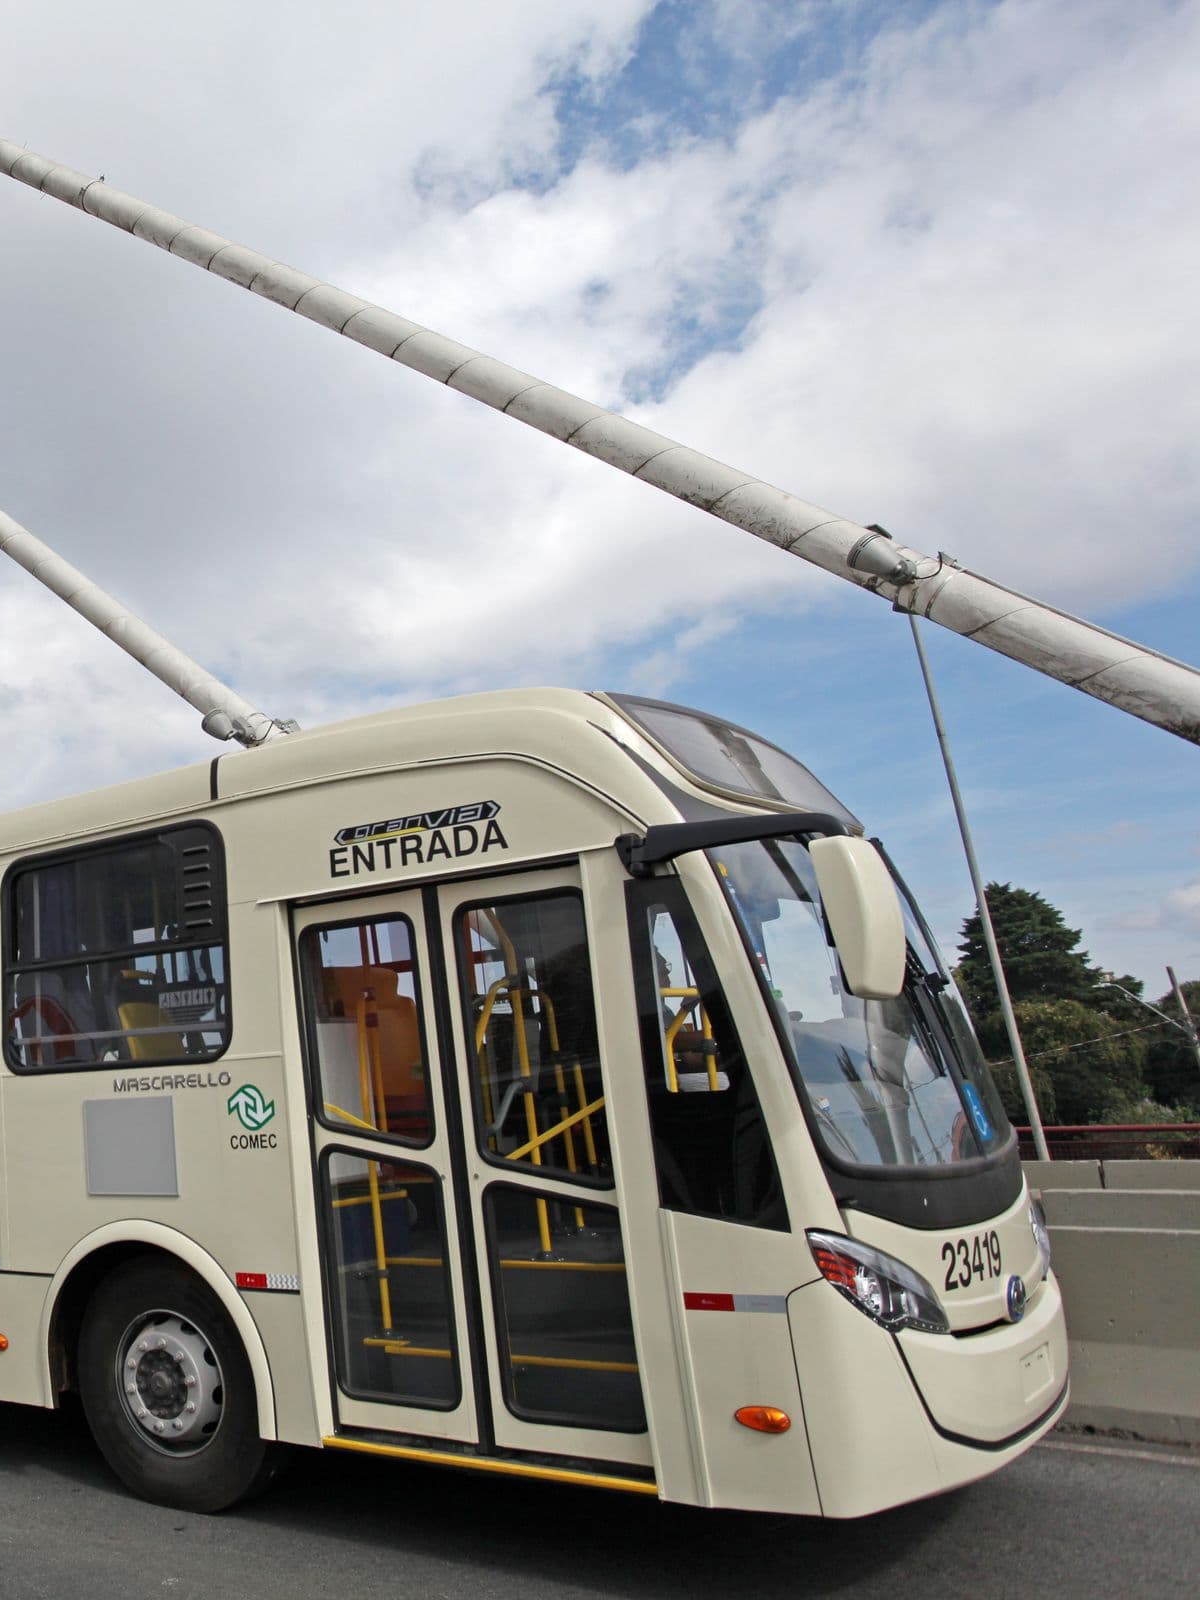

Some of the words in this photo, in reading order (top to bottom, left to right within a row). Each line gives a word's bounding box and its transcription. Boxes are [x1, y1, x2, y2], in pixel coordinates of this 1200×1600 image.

[329, 819, 509, 878] ENTRADA
[113, 1071, 232, 1093] MASCARELLO
[230, 1134, 277, 1150] COMEC
[941, 1230, 1001, 1292] 23419
